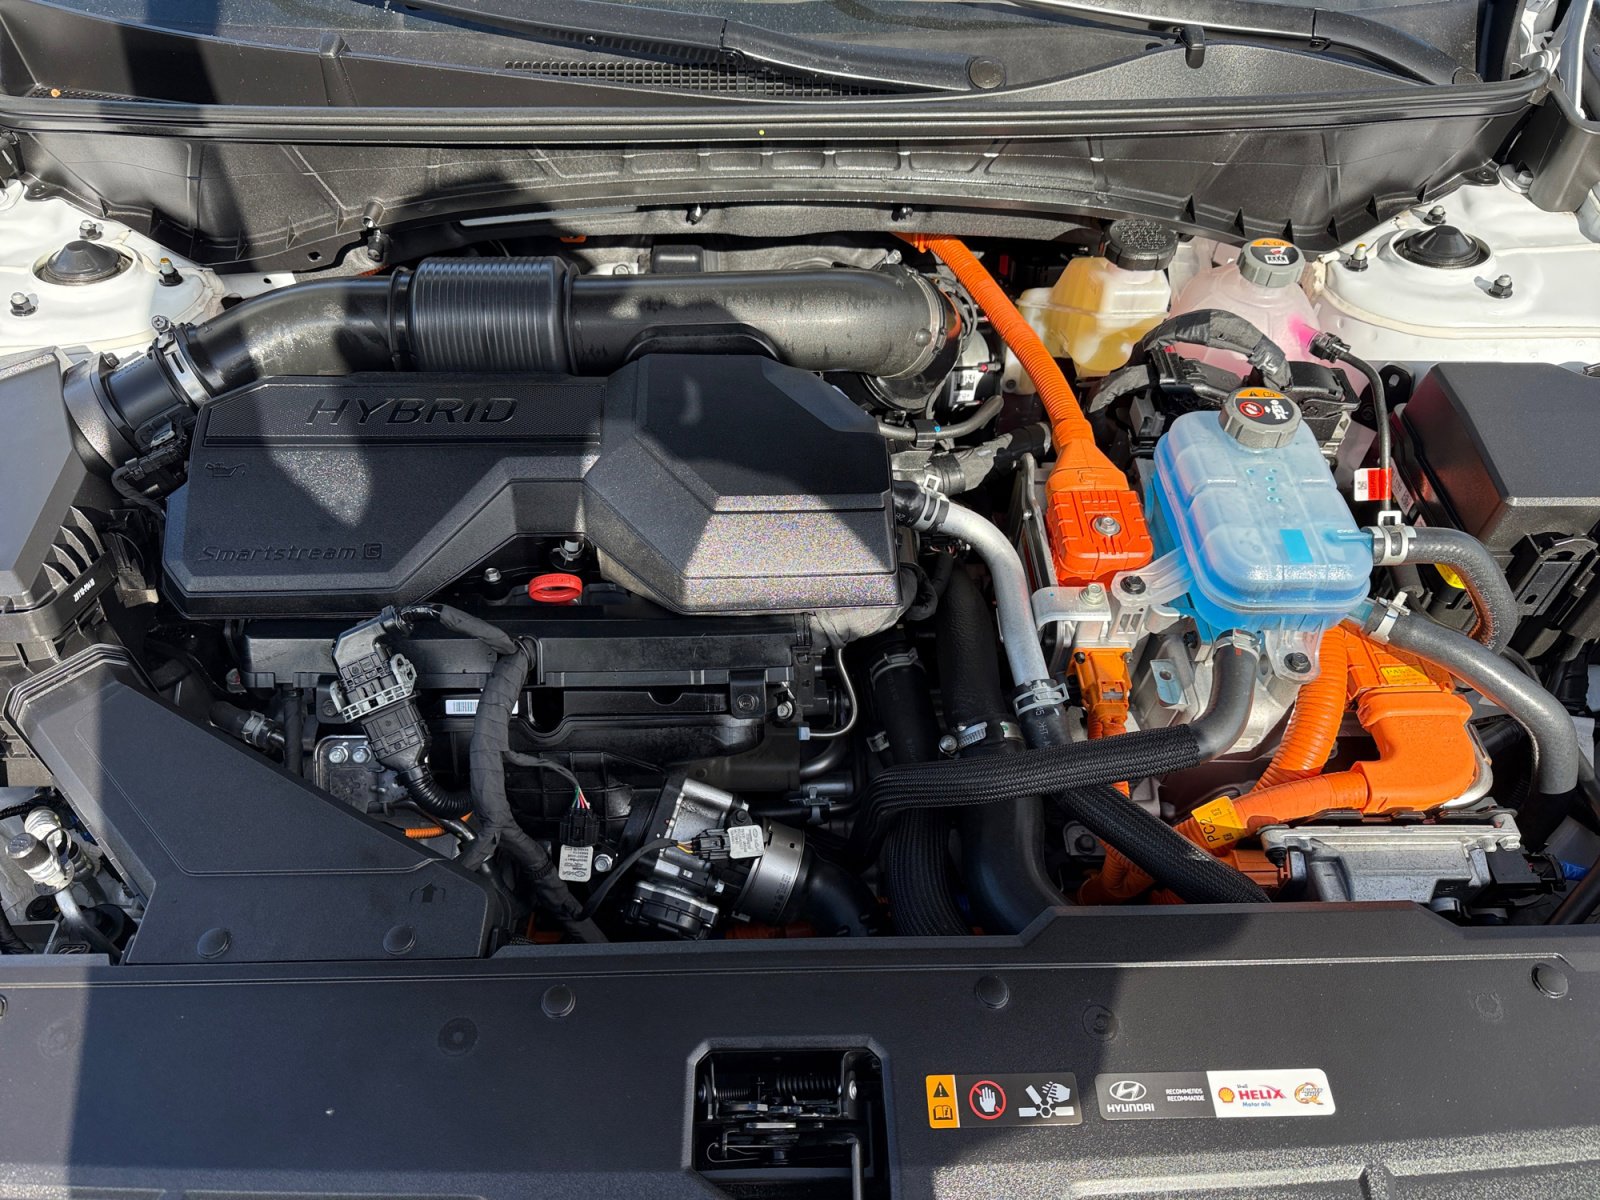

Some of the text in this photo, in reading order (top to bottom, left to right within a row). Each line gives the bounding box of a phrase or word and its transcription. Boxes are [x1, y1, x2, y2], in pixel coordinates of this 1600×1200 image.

[305, 397, 518, 425] HYBRID
[198, 543, 383, 562] Smartstream G
[1199, 816, 1221, 843] PC2
[1238, 1088, 1286, 1100] HELIX
[1107, 1103, 1155, 1113] HYUNDAI
